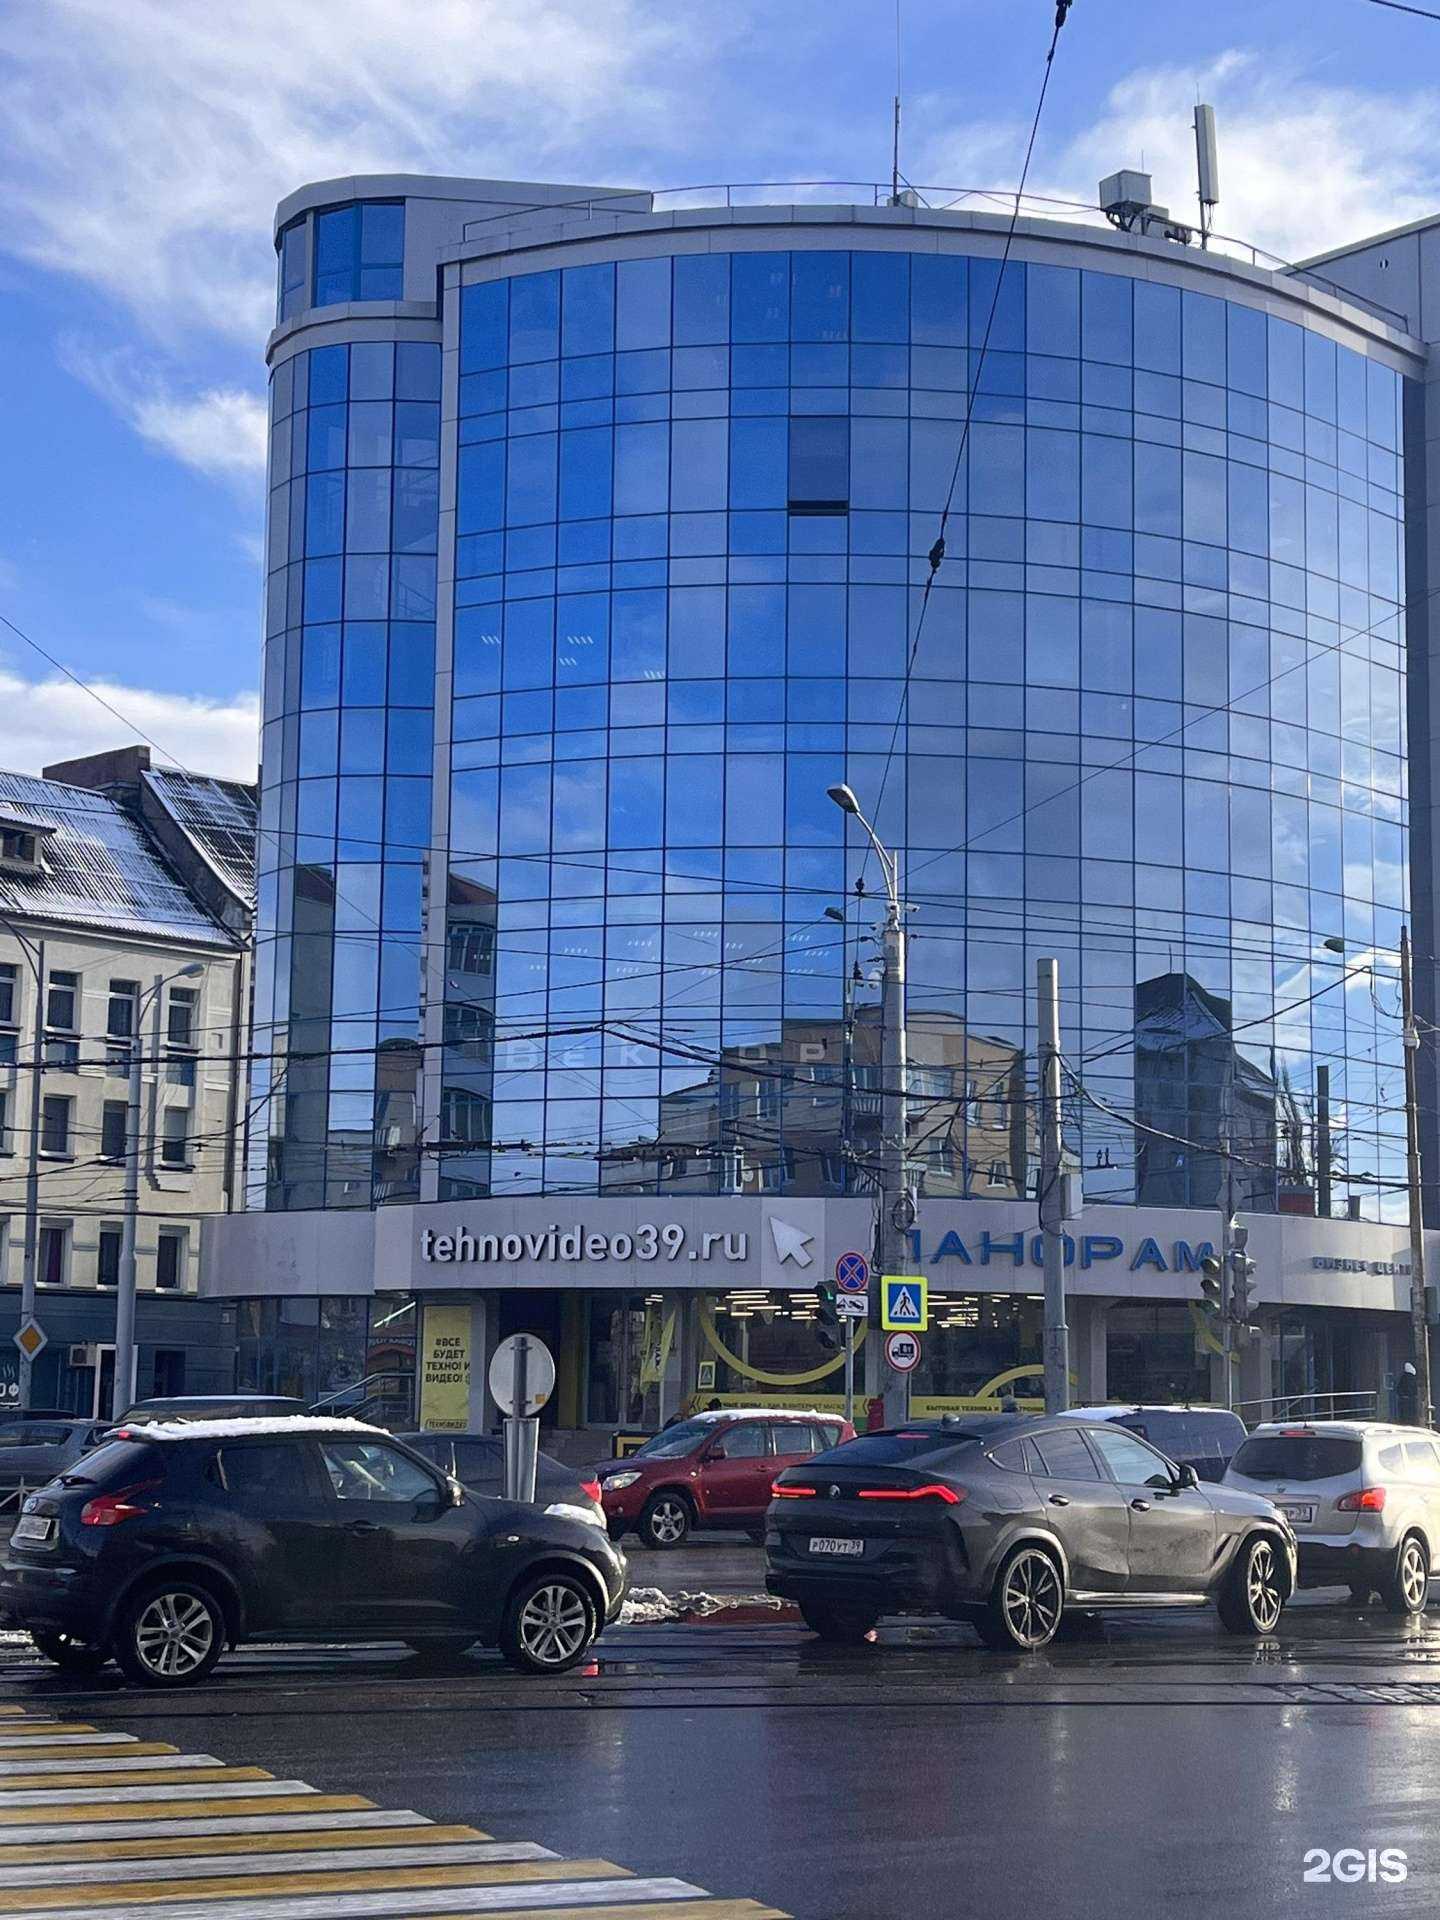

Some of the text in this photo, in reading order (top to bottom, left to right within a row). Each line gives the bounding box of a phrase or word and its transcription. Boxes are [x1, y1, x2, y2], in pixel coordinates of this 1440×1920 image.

[421, 1223, 747, 1262] tehnovideo39.ru
[908, 1229, 1216, 1272] АНОРАМ
[1373, 1261, 1412, 1276] ЦЕНТ
[433, 1349, 466, 1360] БУДЕТ
[426, 1361, 461, 1371] ТЕХНО!
[425, 1373, 463, 1384] ВИДЕО!
